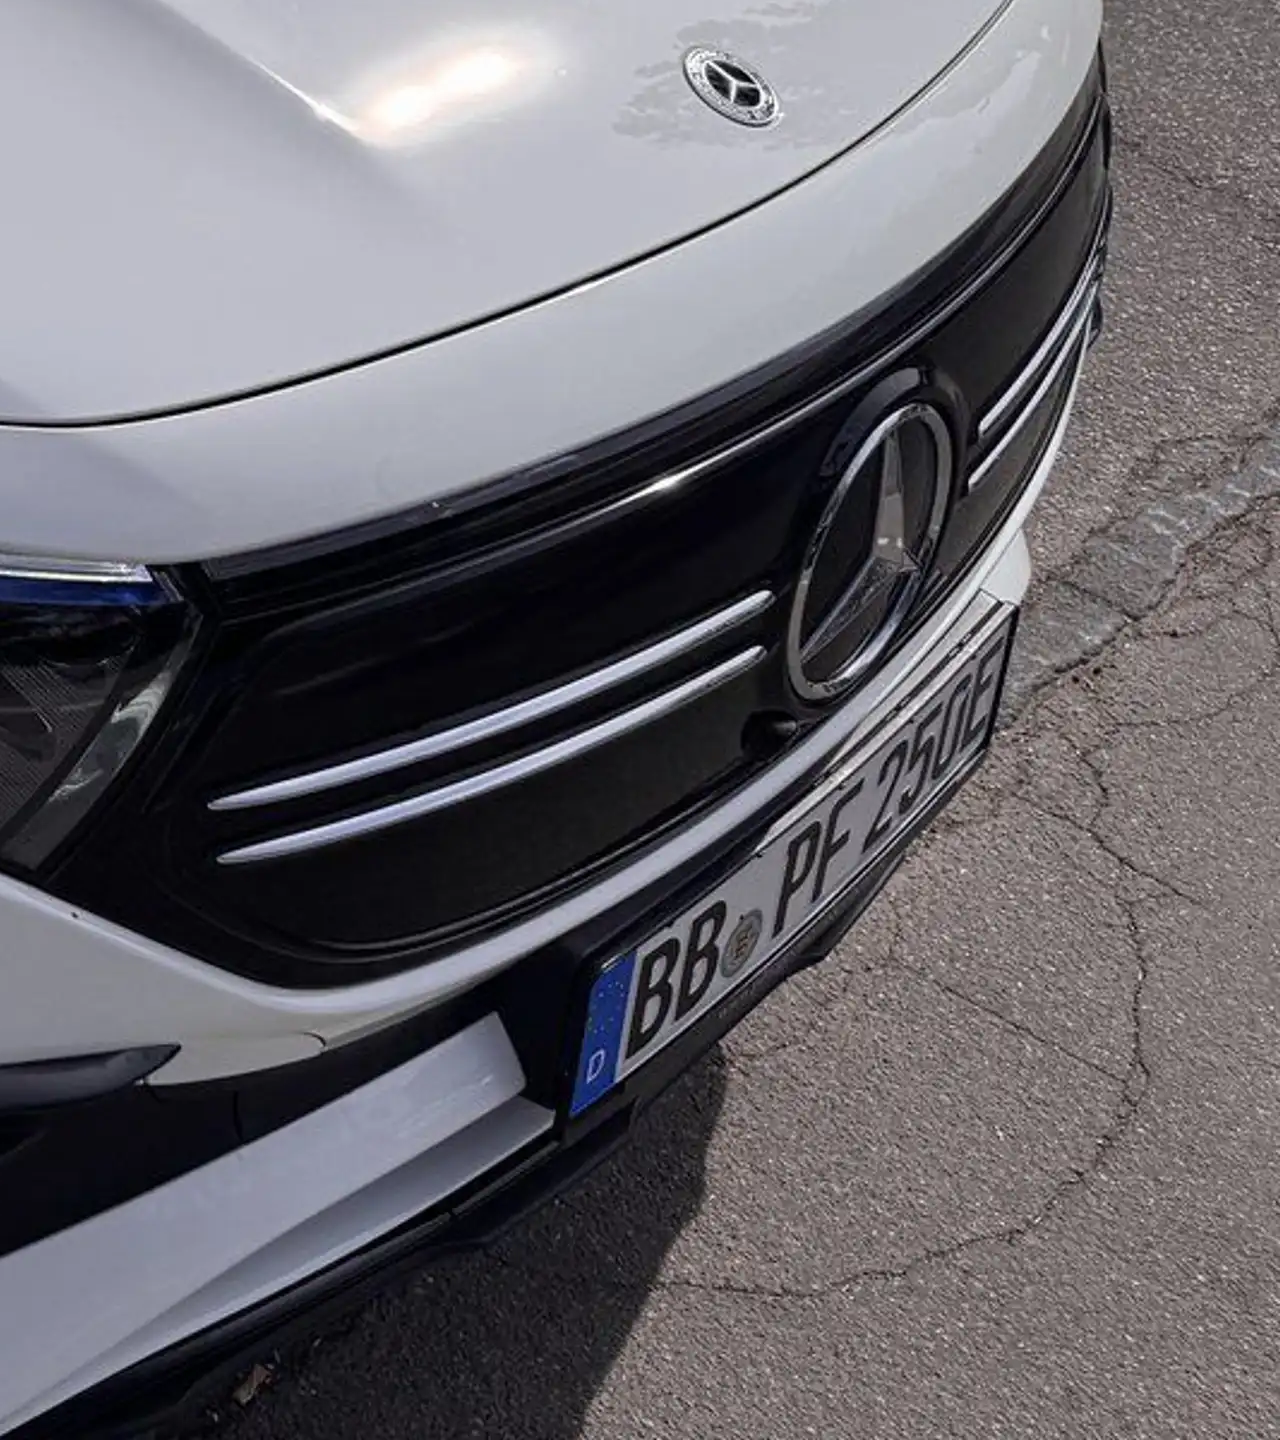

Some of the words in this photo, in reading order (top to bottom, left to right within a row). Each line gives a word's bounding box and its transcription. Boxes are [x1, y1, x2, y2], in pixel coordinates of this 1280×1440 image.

[623, 899, 728, 1060] BB
[771, 776, 866, 939] PF
[861, 635, 1005, 855] 250E
[586, 1049, 606, 1084] D
